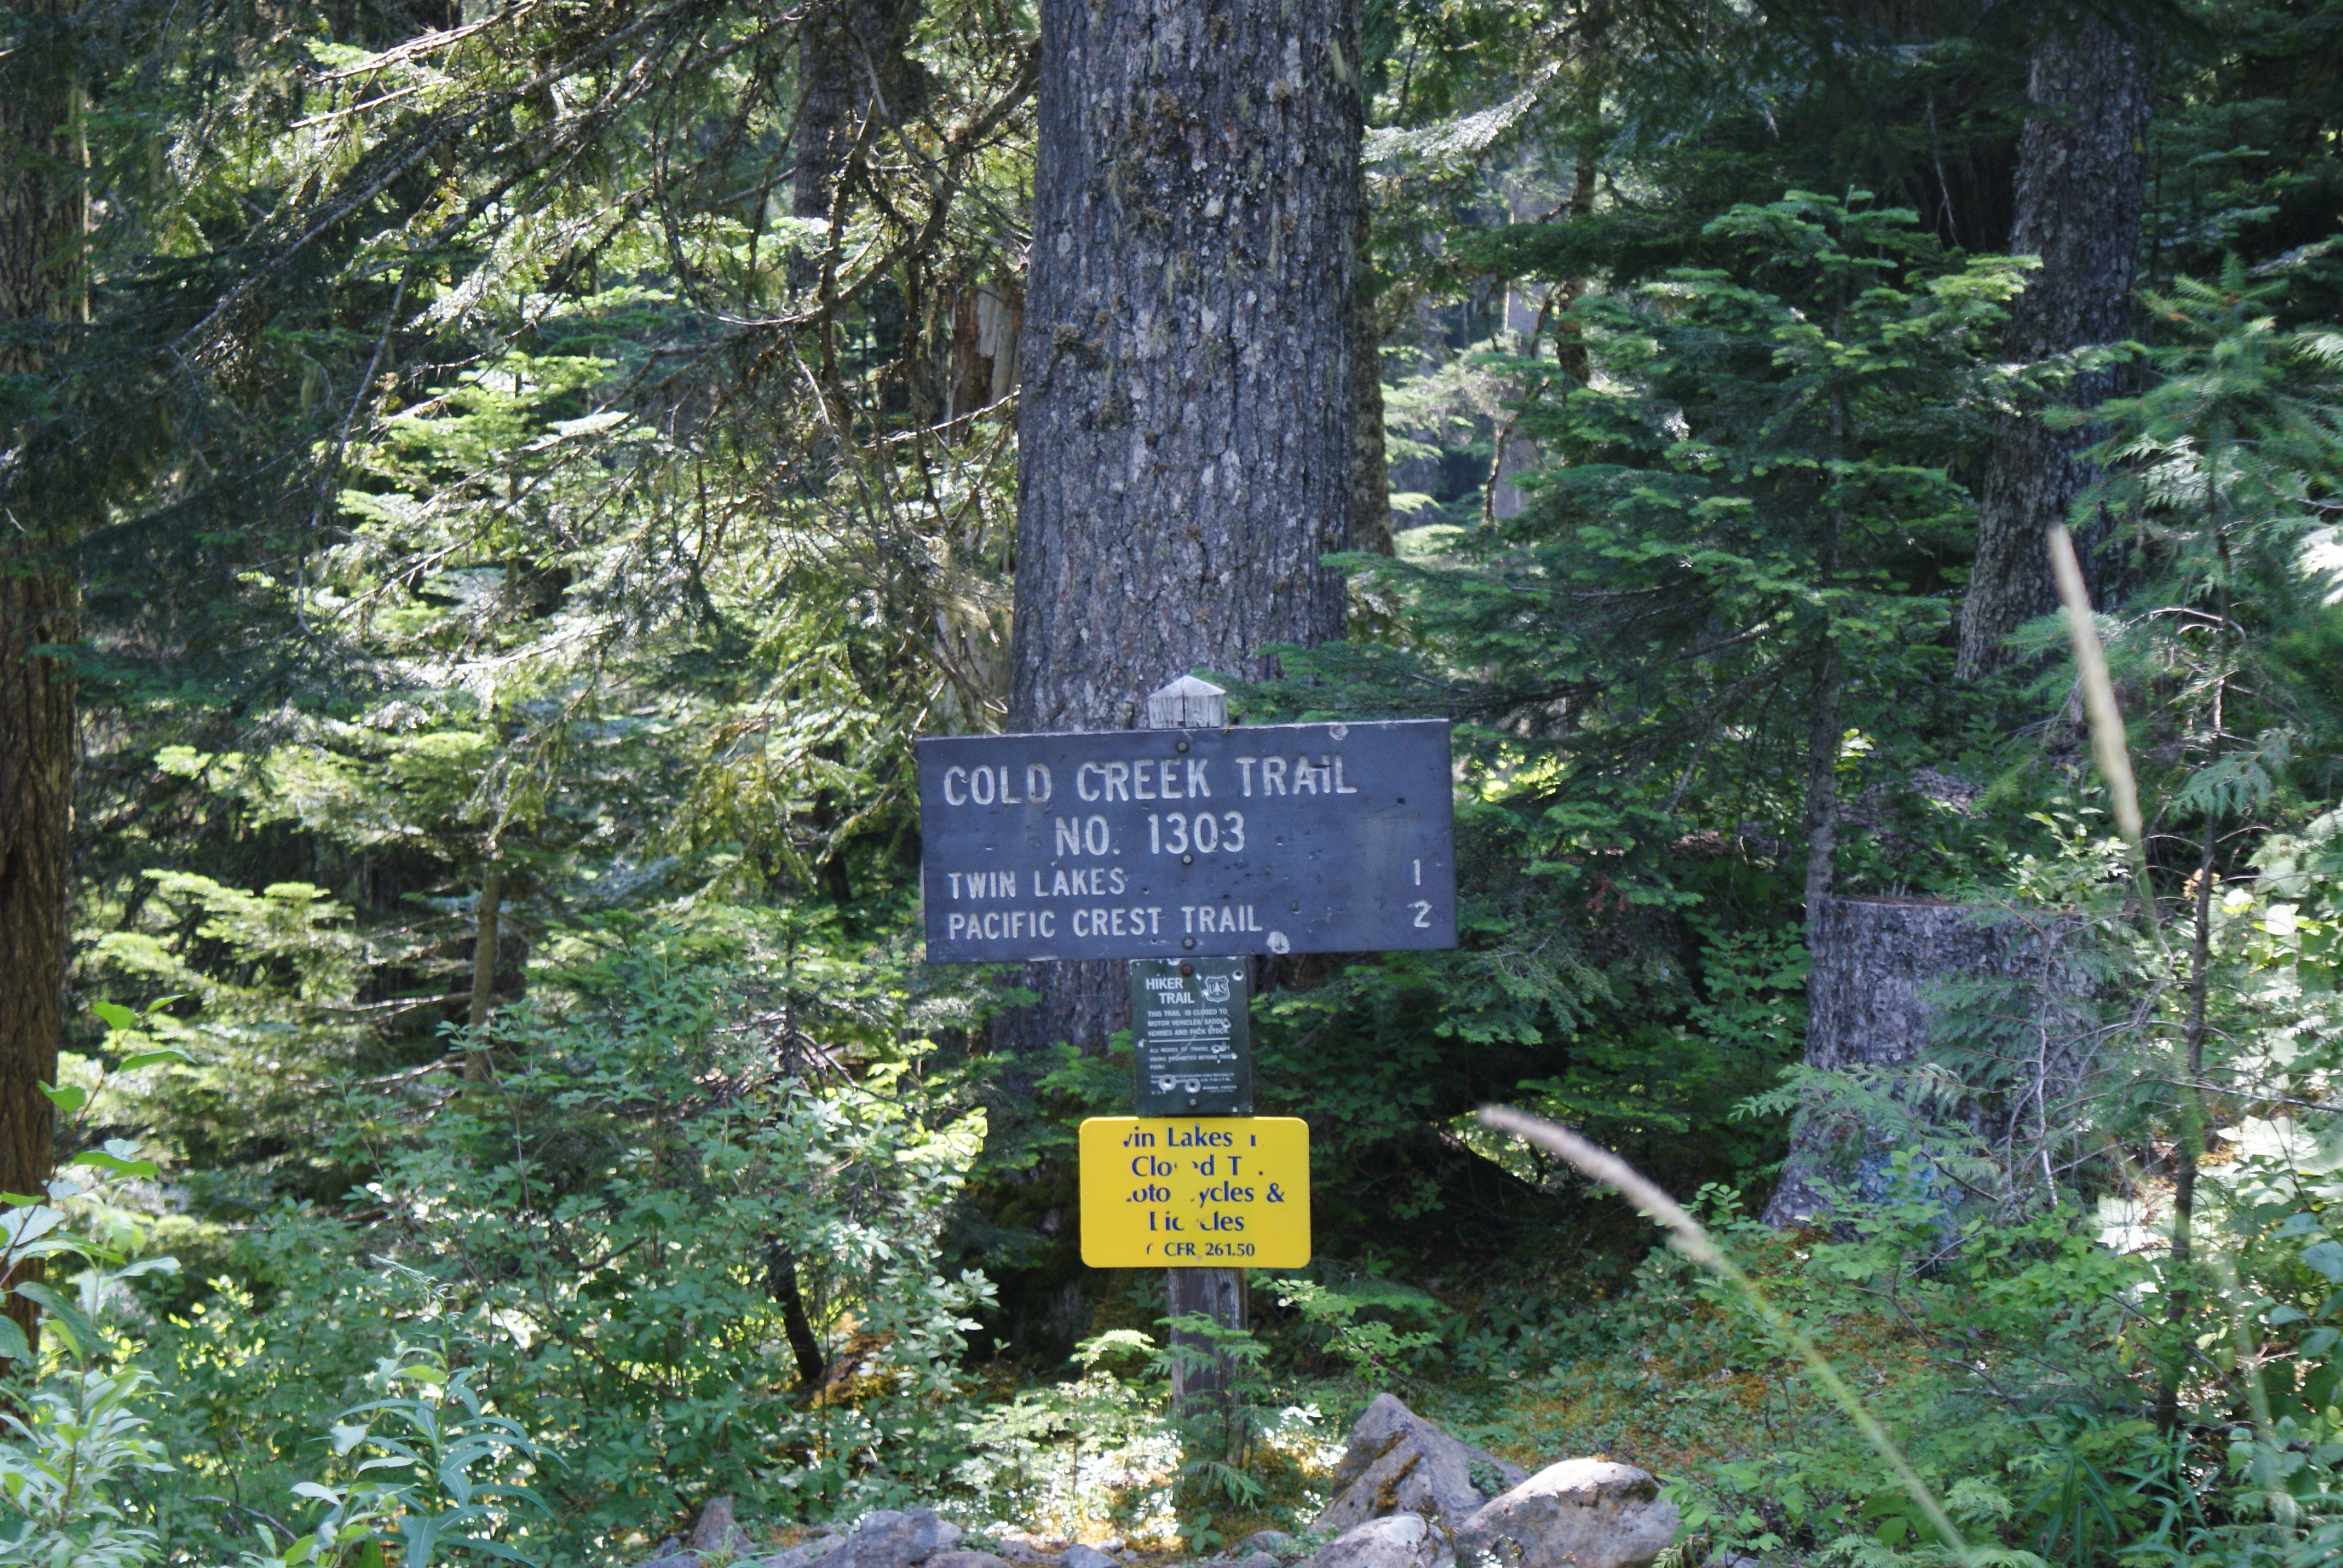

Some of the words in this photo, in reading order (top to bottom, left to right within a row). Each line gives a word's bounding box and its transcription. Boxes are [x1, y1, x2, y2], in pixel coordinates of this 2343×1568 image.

[944, 763, 1052, 806] COLD
[1077, 758, 1211, 802] CREEK
[1236, 754, 1357, 796] TRAIL
[1055, 815, 1121, 857] NO.
[1149, 811, 1245, 854] 1303
[948, 871, 1016, 899] TWIN
[1034, 867, 1126, 897] LAKES
[1414, 858, 1421, 886] 1
[949, 910, 1055, 939] PACIFIC
[1073, 907, 1162, 937] CREST
[1181, 904, 1263, 933] TRAIL
[1413, 900, 1432, 928] 2
[1145, 977, 1184, 990] HIKER
[1158, 991, 1195, 1004] TRAIL
[1168, 1126, 1233, 1148] Lakes
[1132, 1154, 1214, 1177] Clod
[1266, 1183, 1285, 1203] &
[1164, 1242, 1196, 1256] CFR
[1205, 1242, 1255, 1256] 261.50
